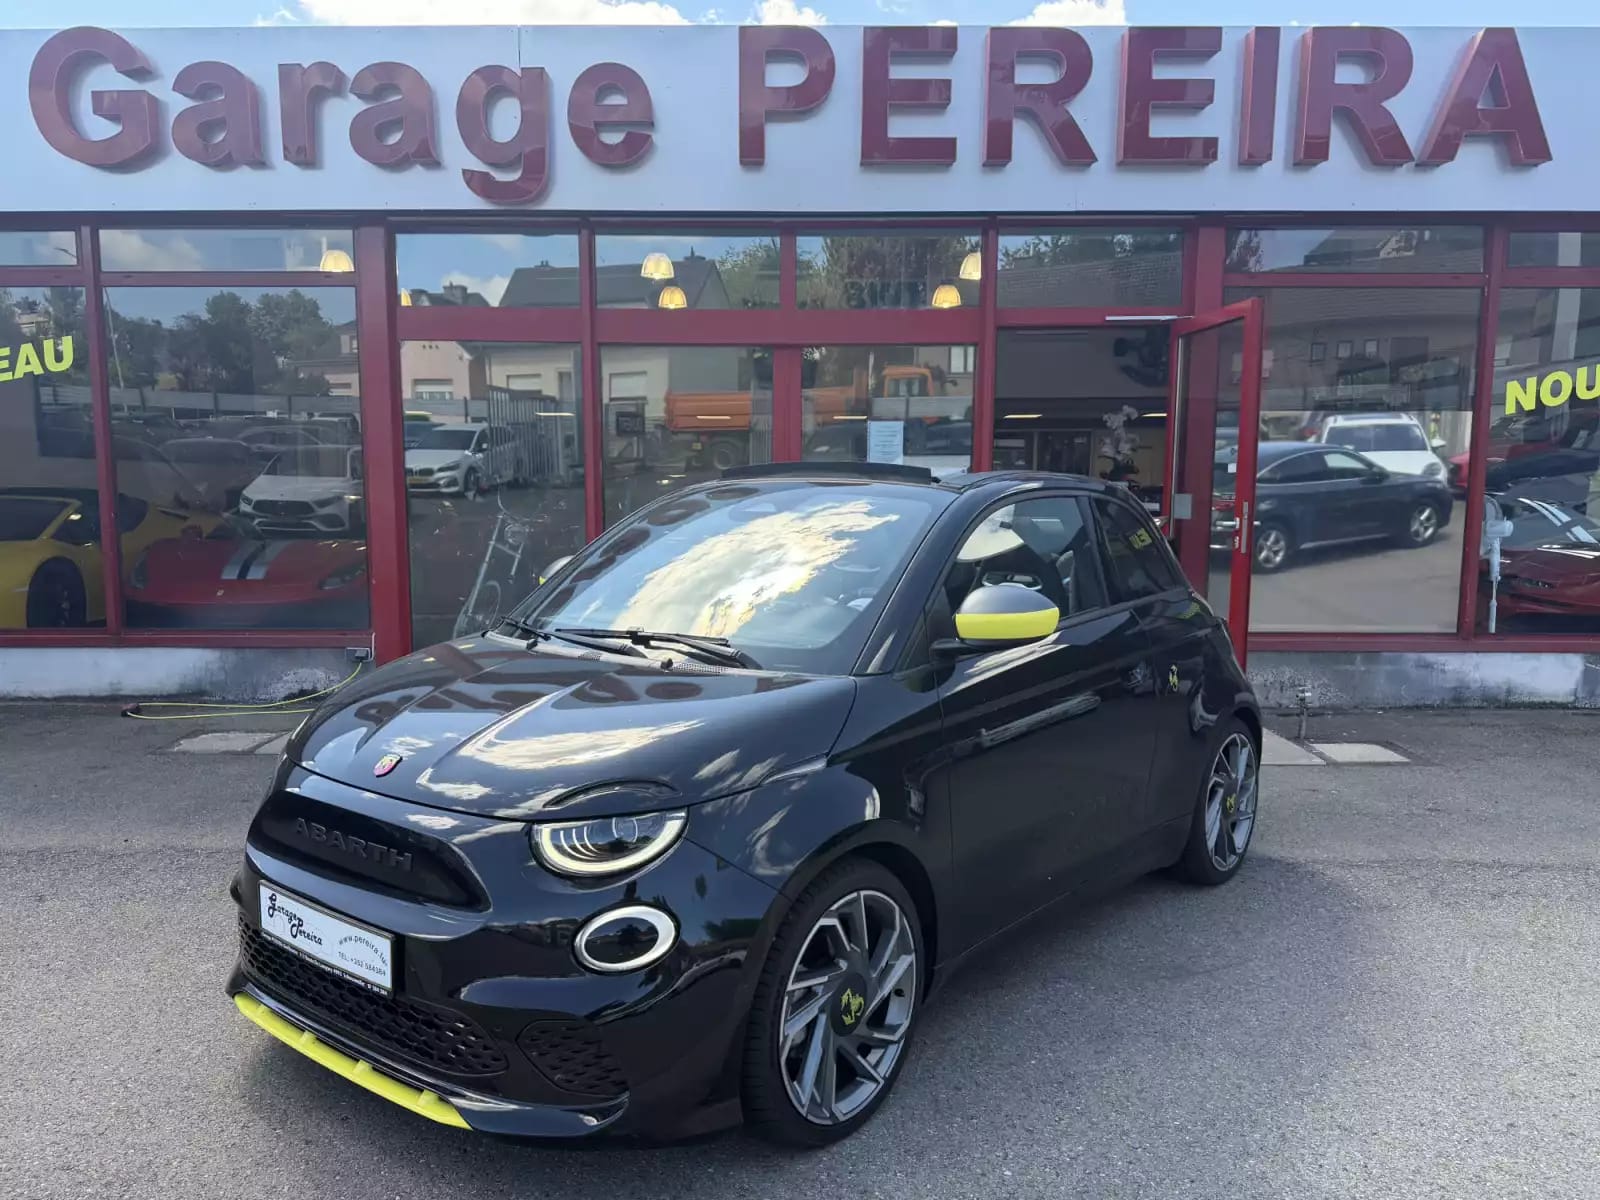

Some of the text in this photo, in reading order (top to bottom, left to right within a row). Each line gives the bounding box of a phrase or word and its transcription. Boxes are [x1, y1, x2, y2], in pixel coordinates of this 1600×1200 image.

[29, 26, 1551, 206] Garage PEREIRA
[1505, 363, 1600, 415] NOU
[296, 817, 414, 871] ABARTH
[267, 893, 299, 924] Garage
[290, 917, 323, 945] Pereira
